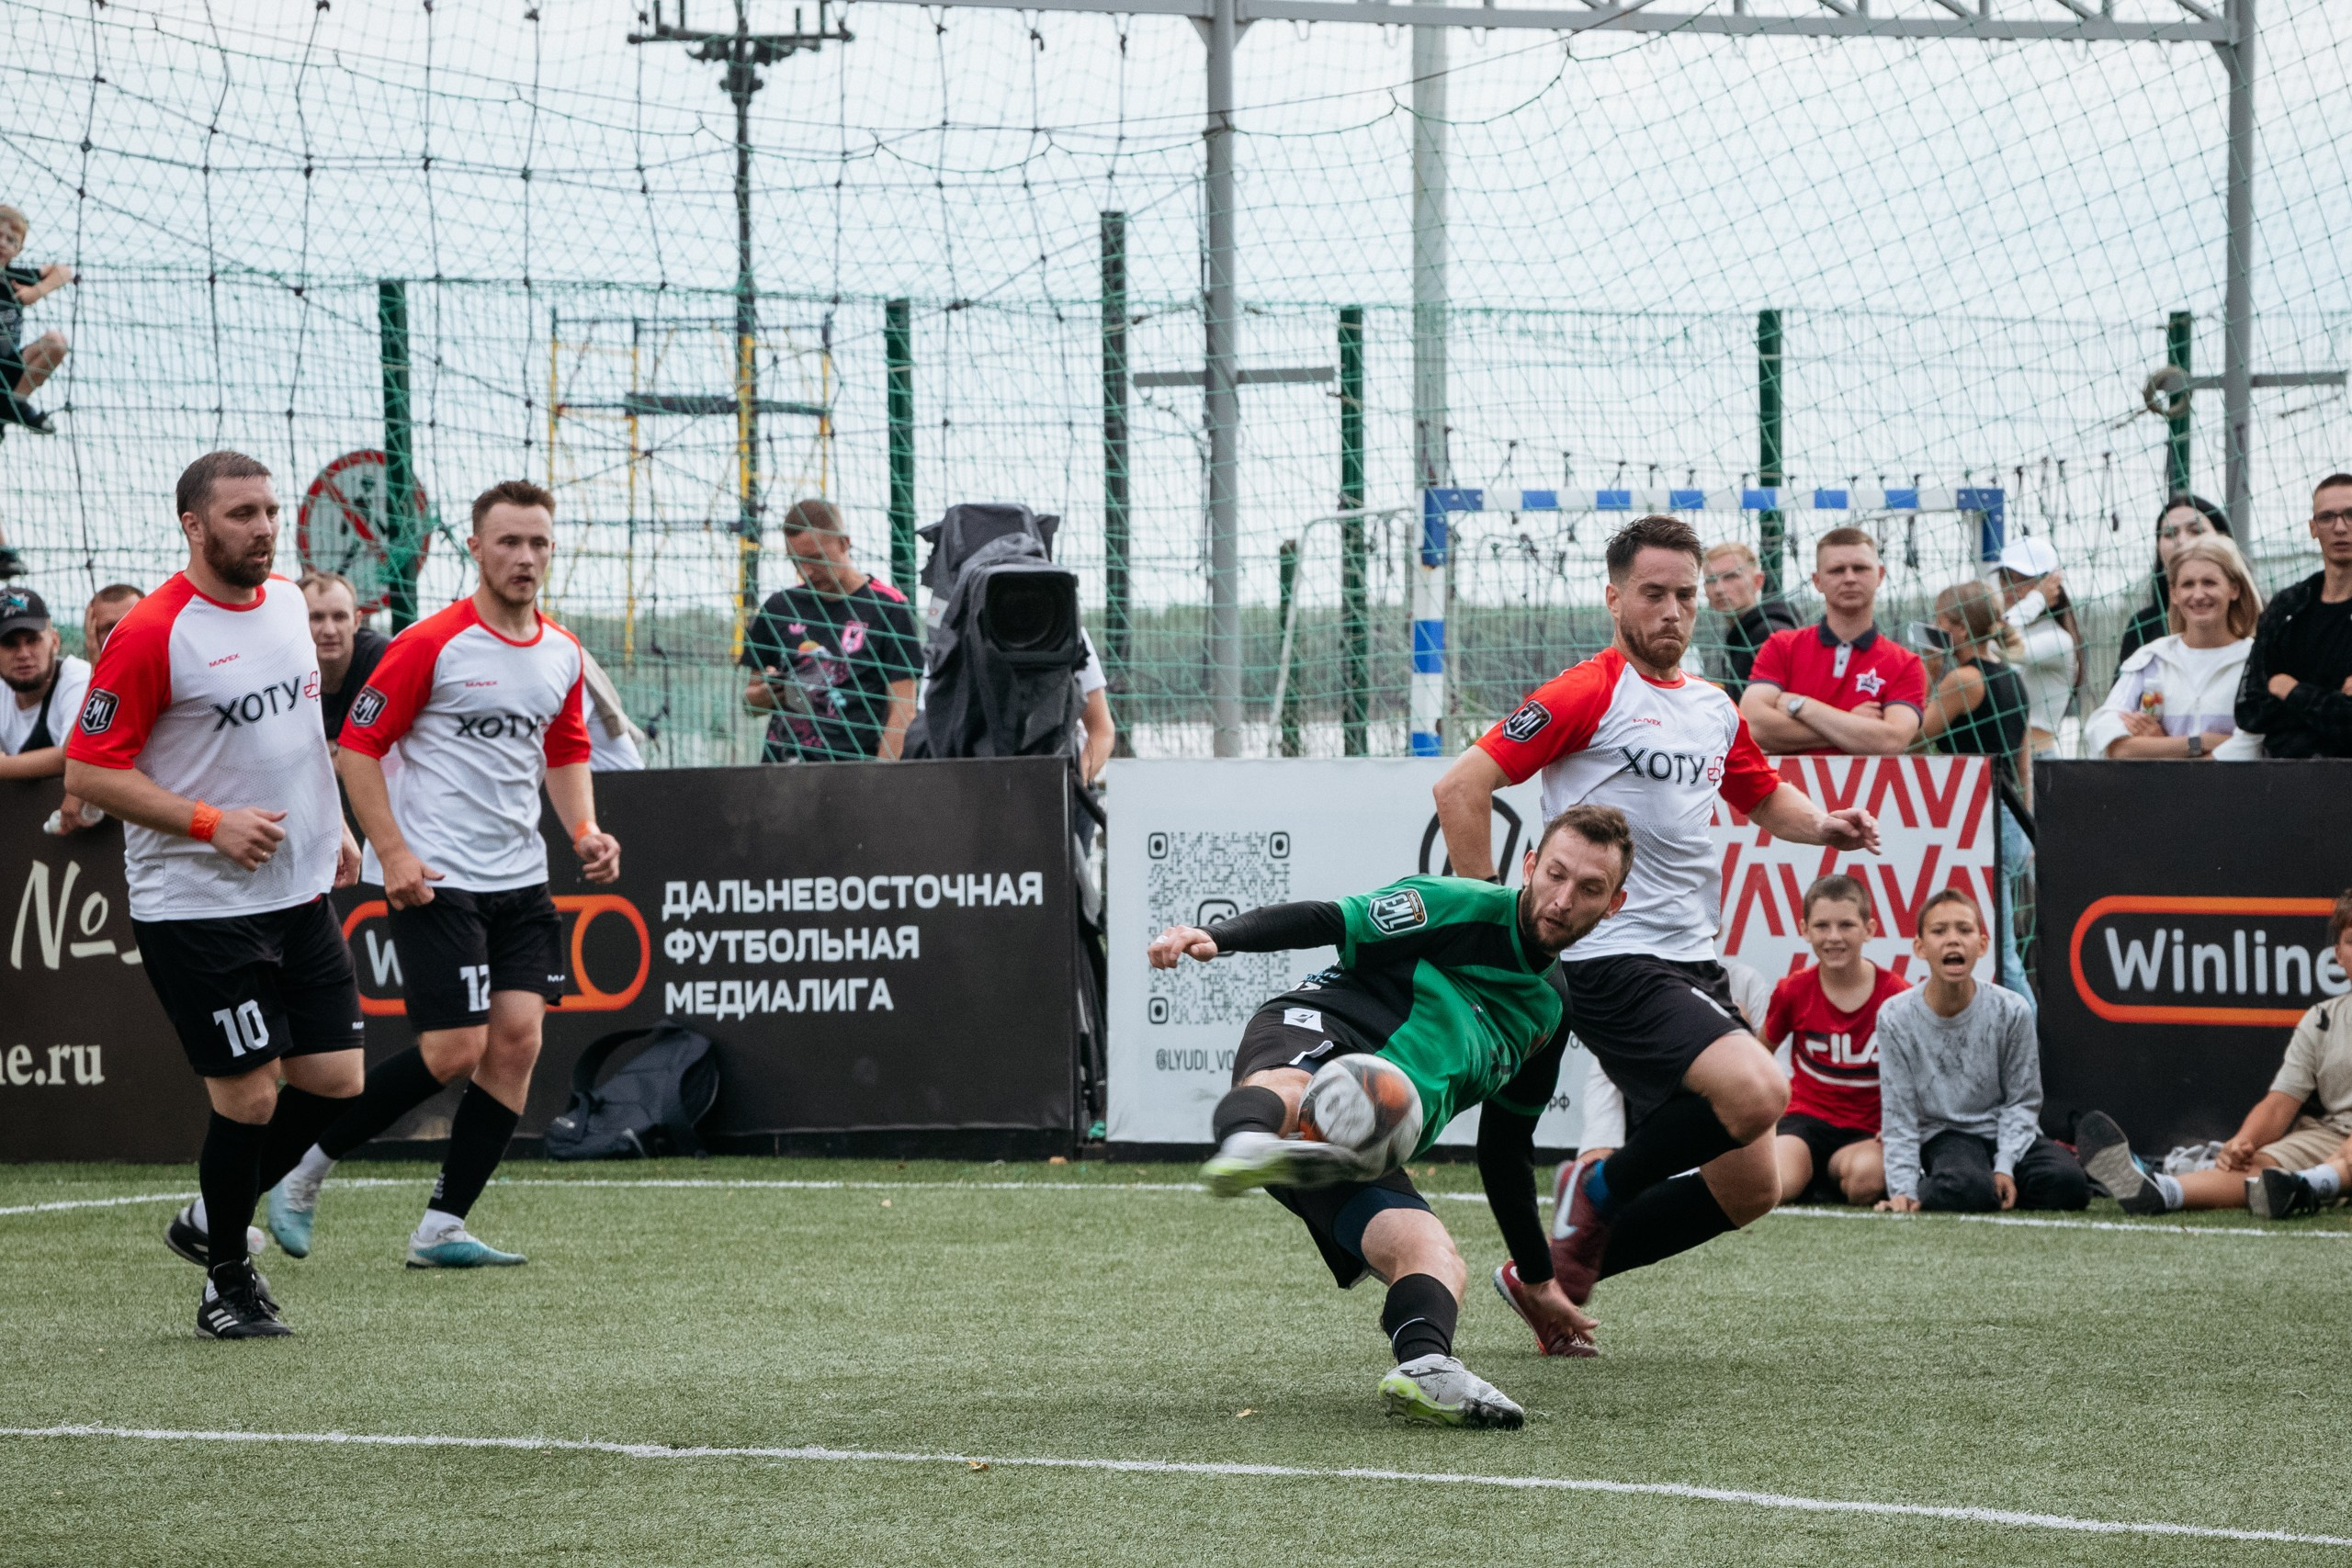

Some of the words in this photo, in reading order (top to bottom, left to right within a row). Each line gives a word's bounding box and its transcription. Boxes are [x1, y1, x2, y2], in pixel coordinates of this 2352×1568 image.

[82, 698, 110, 731] EML
[352, 694, 379, 724] EML
[662, 872, 1044, 921] ДАЛЬНЕВОСТОЧНАЯ
[1374, 894, 1415, 929] EML
[663, 925, 920, 964] ФУТБОЛЬНАЯ
[2105, 927, 2352, 997] Winline
[664, 977, 894, 1021] МЕДИАЛИГА
[212, 998, 270, 1057] 10
